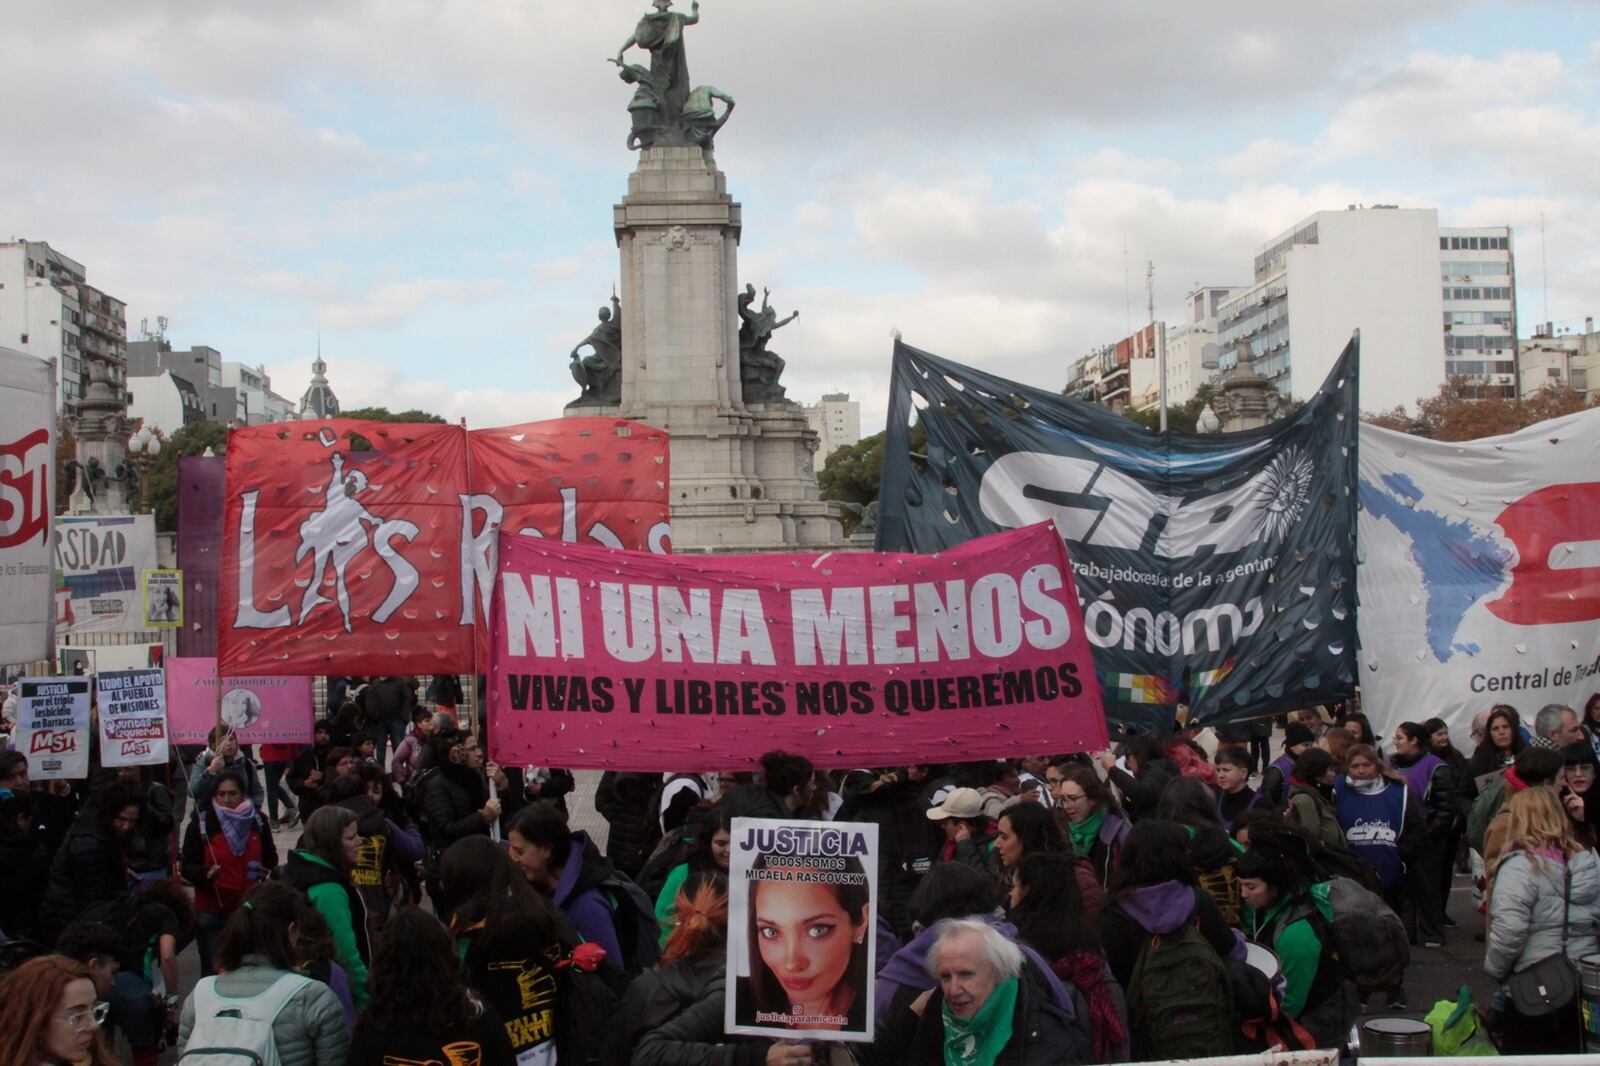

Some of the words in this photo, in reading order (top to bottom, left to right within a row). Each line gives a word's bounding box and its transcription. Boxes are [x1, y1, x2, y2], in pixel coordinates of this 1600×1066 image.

[1173, 573, 1193, 588] de
[502, 572, 584, 659] NI
[600, 581, 777, 665] UNA
[790, 563, 1071, 666] MENOS
[100, 677, 122, 690] TODO
[123, 676, 133, 688] EL
[133, 673, 162, 688] APOYO
[1470, 667, 1549, 693] Central
[1553, 665, 1572, 687] de
[36, 683, 69, 696] JUSTICIA
[111, 690, 122, 701] AL
[122, 686, 154, 701] PUEBLO
[507, 673, 614, 712] VIVAS
[623, 678, 645, 713] Y
[655, 679, 785, 715] LIBRES
[795, 680, 874, 716] NOS
[884, 662, 1082, 716] QUEREMOS
[31, 697, 44, 709] por
[53, 694, 75, 708] triple
[108, 702, 120, 714] DE
[120, 699, 160, 714] MISIONES
[34, 706, 71, 718] lesbicidio
[42, 717, 75, 728] Barracas
[33, 731, 76, 752] MST
[122, 741, 151, 755] MST
[739, 828, 869, 855] JUSTICIA
[764, 856, 802, 869] TODOS
[805, 858, 846, 870] SOMOS
[745, 869, 793, 882] MICAELA
[796, 872, 866, 885] RASCOVSKY
